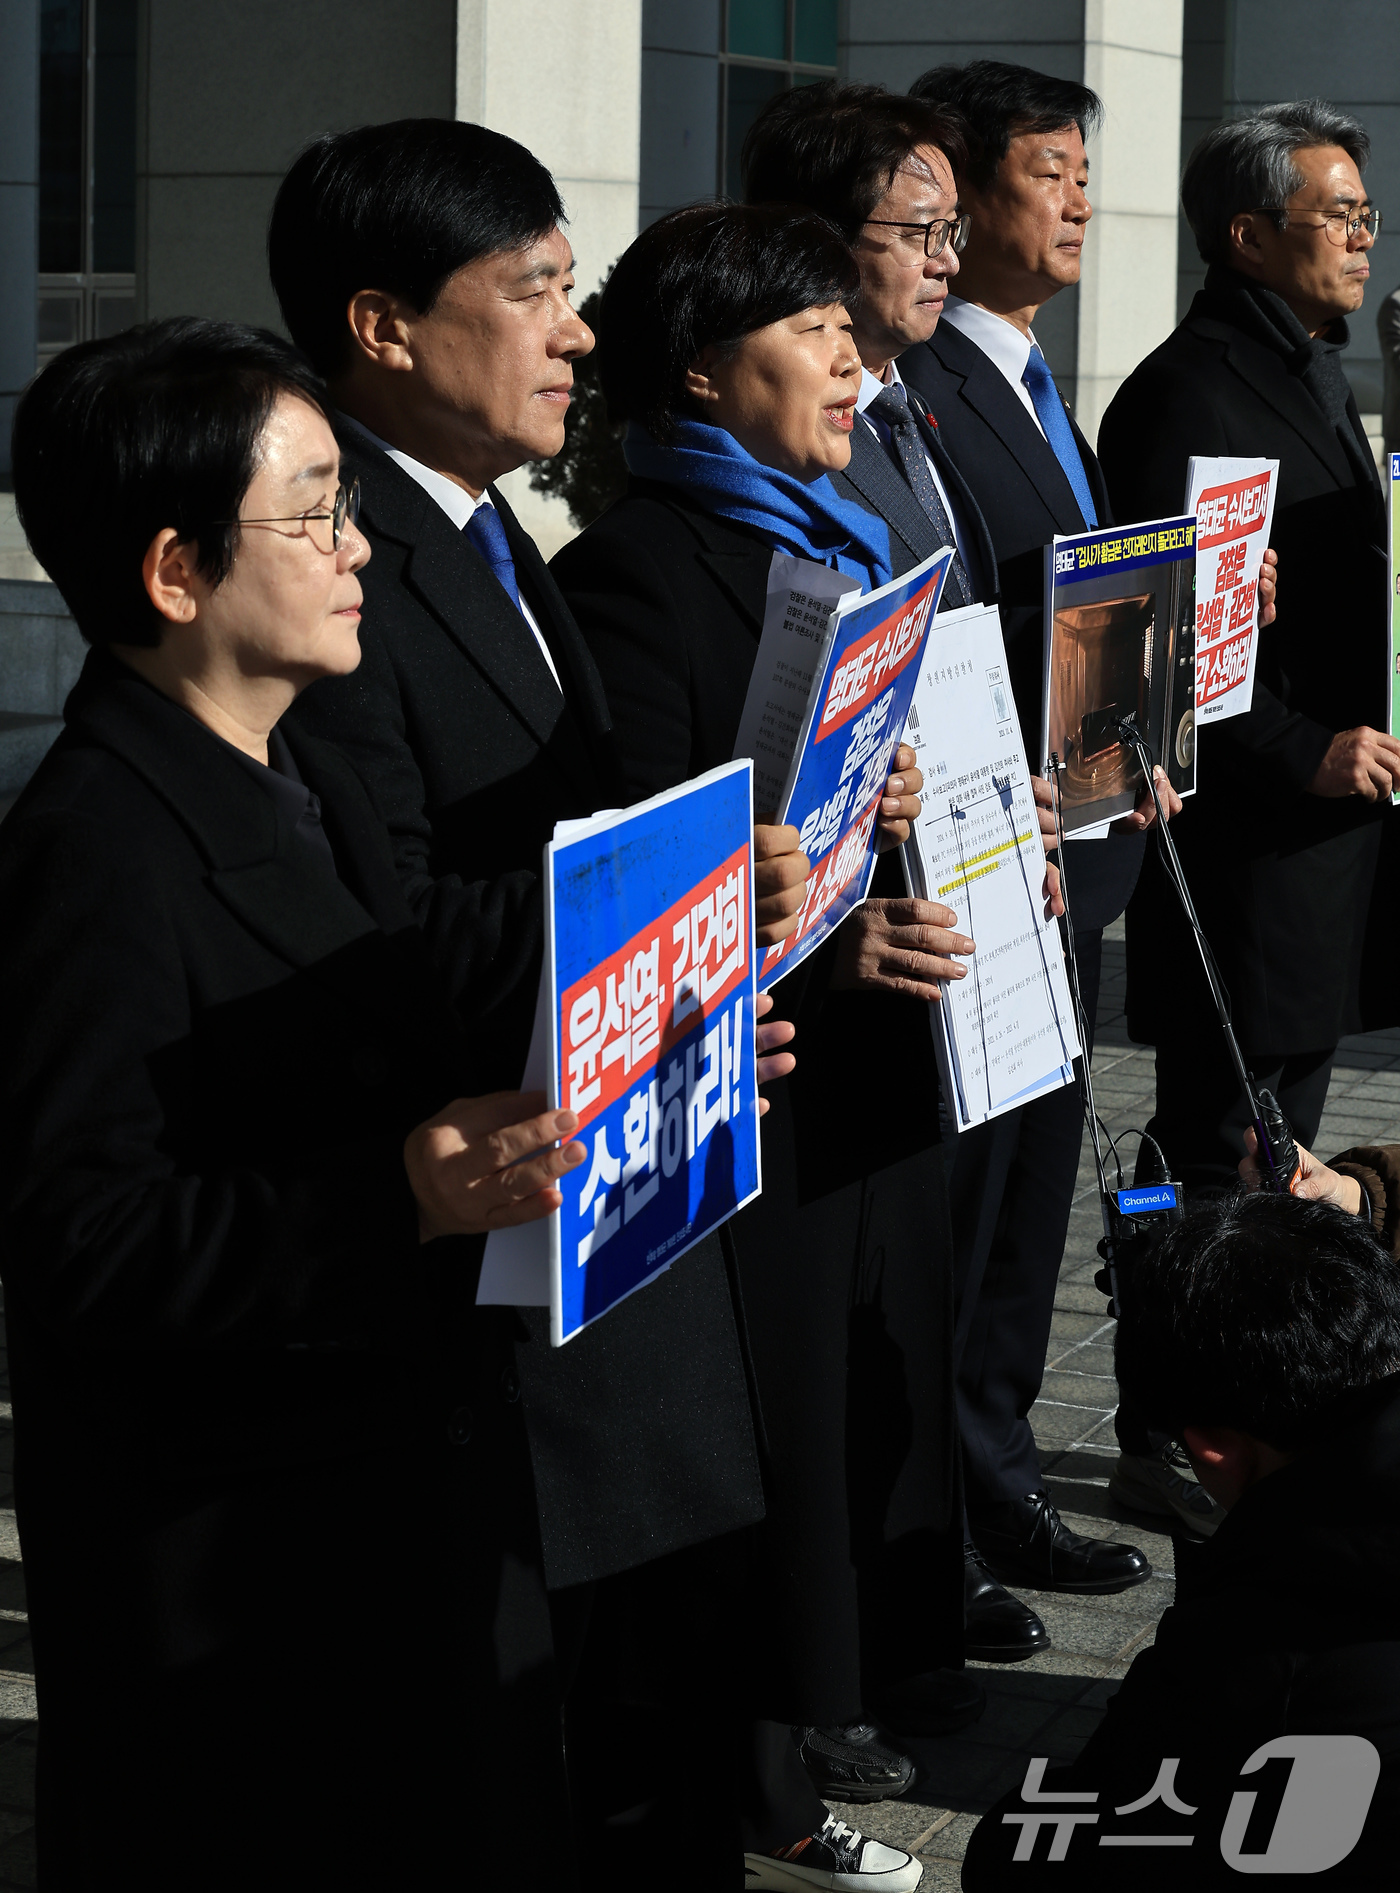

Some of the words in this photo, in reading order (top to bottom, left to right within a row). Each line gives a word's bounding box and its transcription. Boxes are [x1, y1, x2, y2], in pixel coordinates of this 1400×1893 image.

[1198, 495, 1228, 540] 명태균
[1228, 482, 1268, 530] 수사보고서
[1056, 549, 1075, 574] 명태균
[1101, 539, 1122, 564] 황금폰
[1122, 532, 1157, 559] 전자레인지
[1215, 541, 1246, 595] 검찰은
[787, 605, 802, 619] 검찰은
[790, 591, 806, 605] 검찰은
[823, 640, 880, 724] 명태균
[873, 585, 936, 686] 수사보고서
[1206, 632, 1251, 696] 소환하라
[838, 687, 894, 786] 검찰은
[806, 800, 879, 928] 소환하라
[577, 995, 744, 1268] 소환하라!
[1124, 1194, 1161, 1206] Channel
[1162, 1192, 1170, 1202] A
